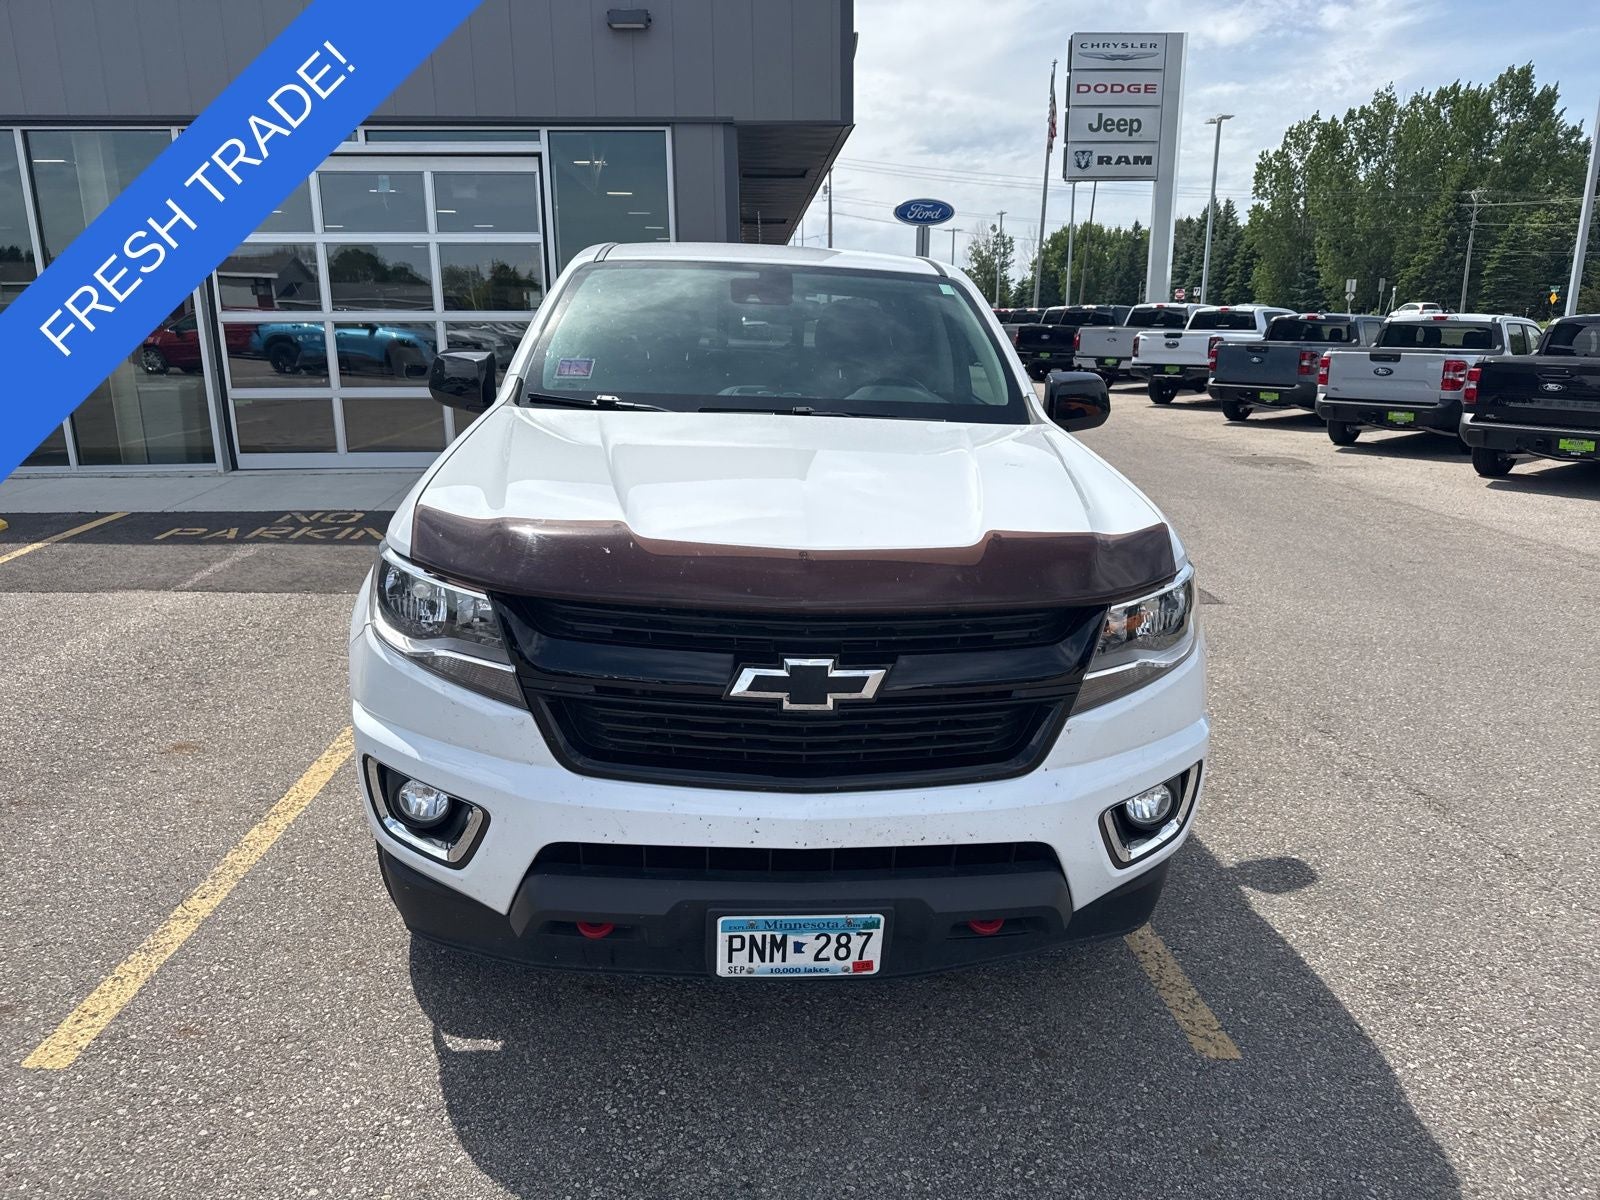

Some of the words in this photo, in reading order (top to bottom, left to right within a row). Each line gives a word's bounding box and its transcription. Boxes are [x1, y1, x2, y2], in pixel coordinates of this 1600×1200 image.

[1076, 83, 1158, 94] DODGE
[1088, 112, 1143, 137] Jeep
[1097, 155, 1153, 165] RAM
[906, 203, 942, 219] Ford
[274, 511, 366, 524] NO
[153, 526, 384, 540] PARKIN
[727, 933, 788, 963] PNM
[813, 931, 874, 961] 287
[727, 965, 745, 974] SEP
[770, 967, 801, 975] 10,000
